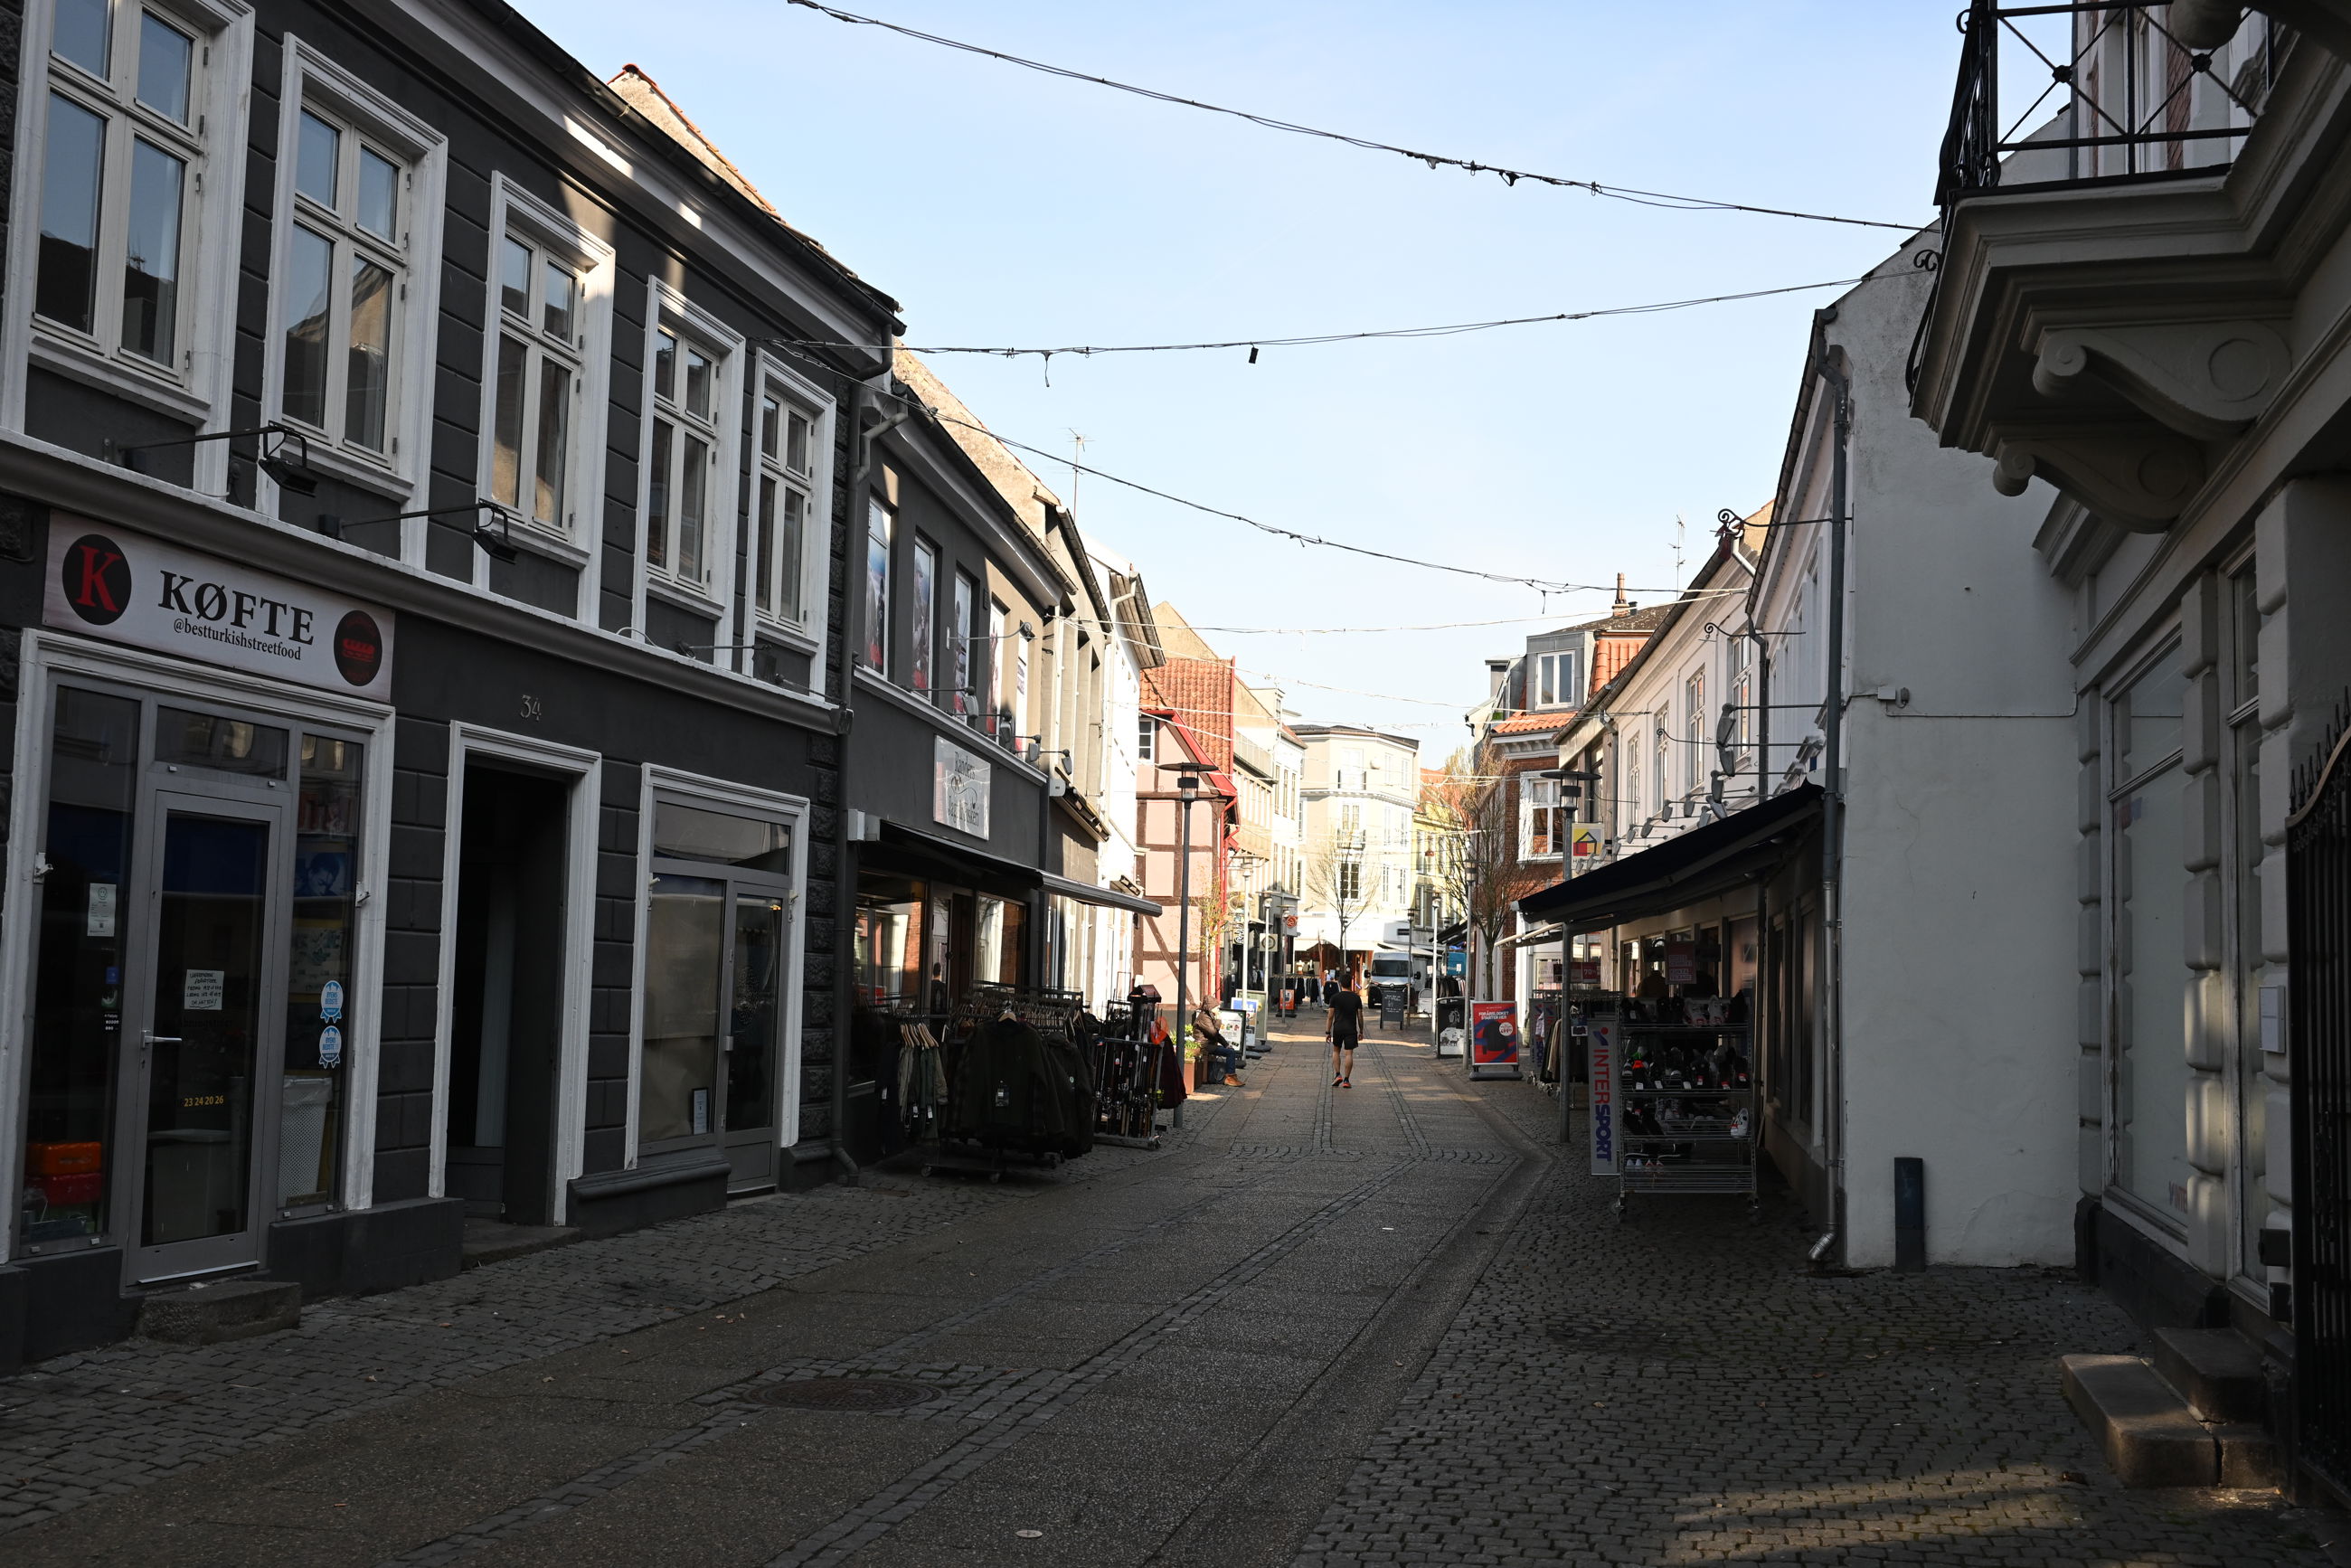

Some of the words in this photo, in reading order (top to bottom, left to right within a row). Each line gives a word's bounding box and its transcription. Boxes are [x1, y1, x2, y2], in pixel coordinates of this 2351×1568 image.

[75, 544, 122, 614] K
[158, 570, 314, 646] KØFTE
[174, 618, 301, 660] @bestturkishstreetfood
[520, 694, 542, 721] 34
[954, 751, 976, 780] Randers
[184, 1098, 194, 1107] 23
[194, 1096, 203, 1106] 24
[204, 1095, 214, 1105] 20
[215, 1094, 224, 1104] 26
[1593, 1049, 1612, 1162] INTERSPORT
